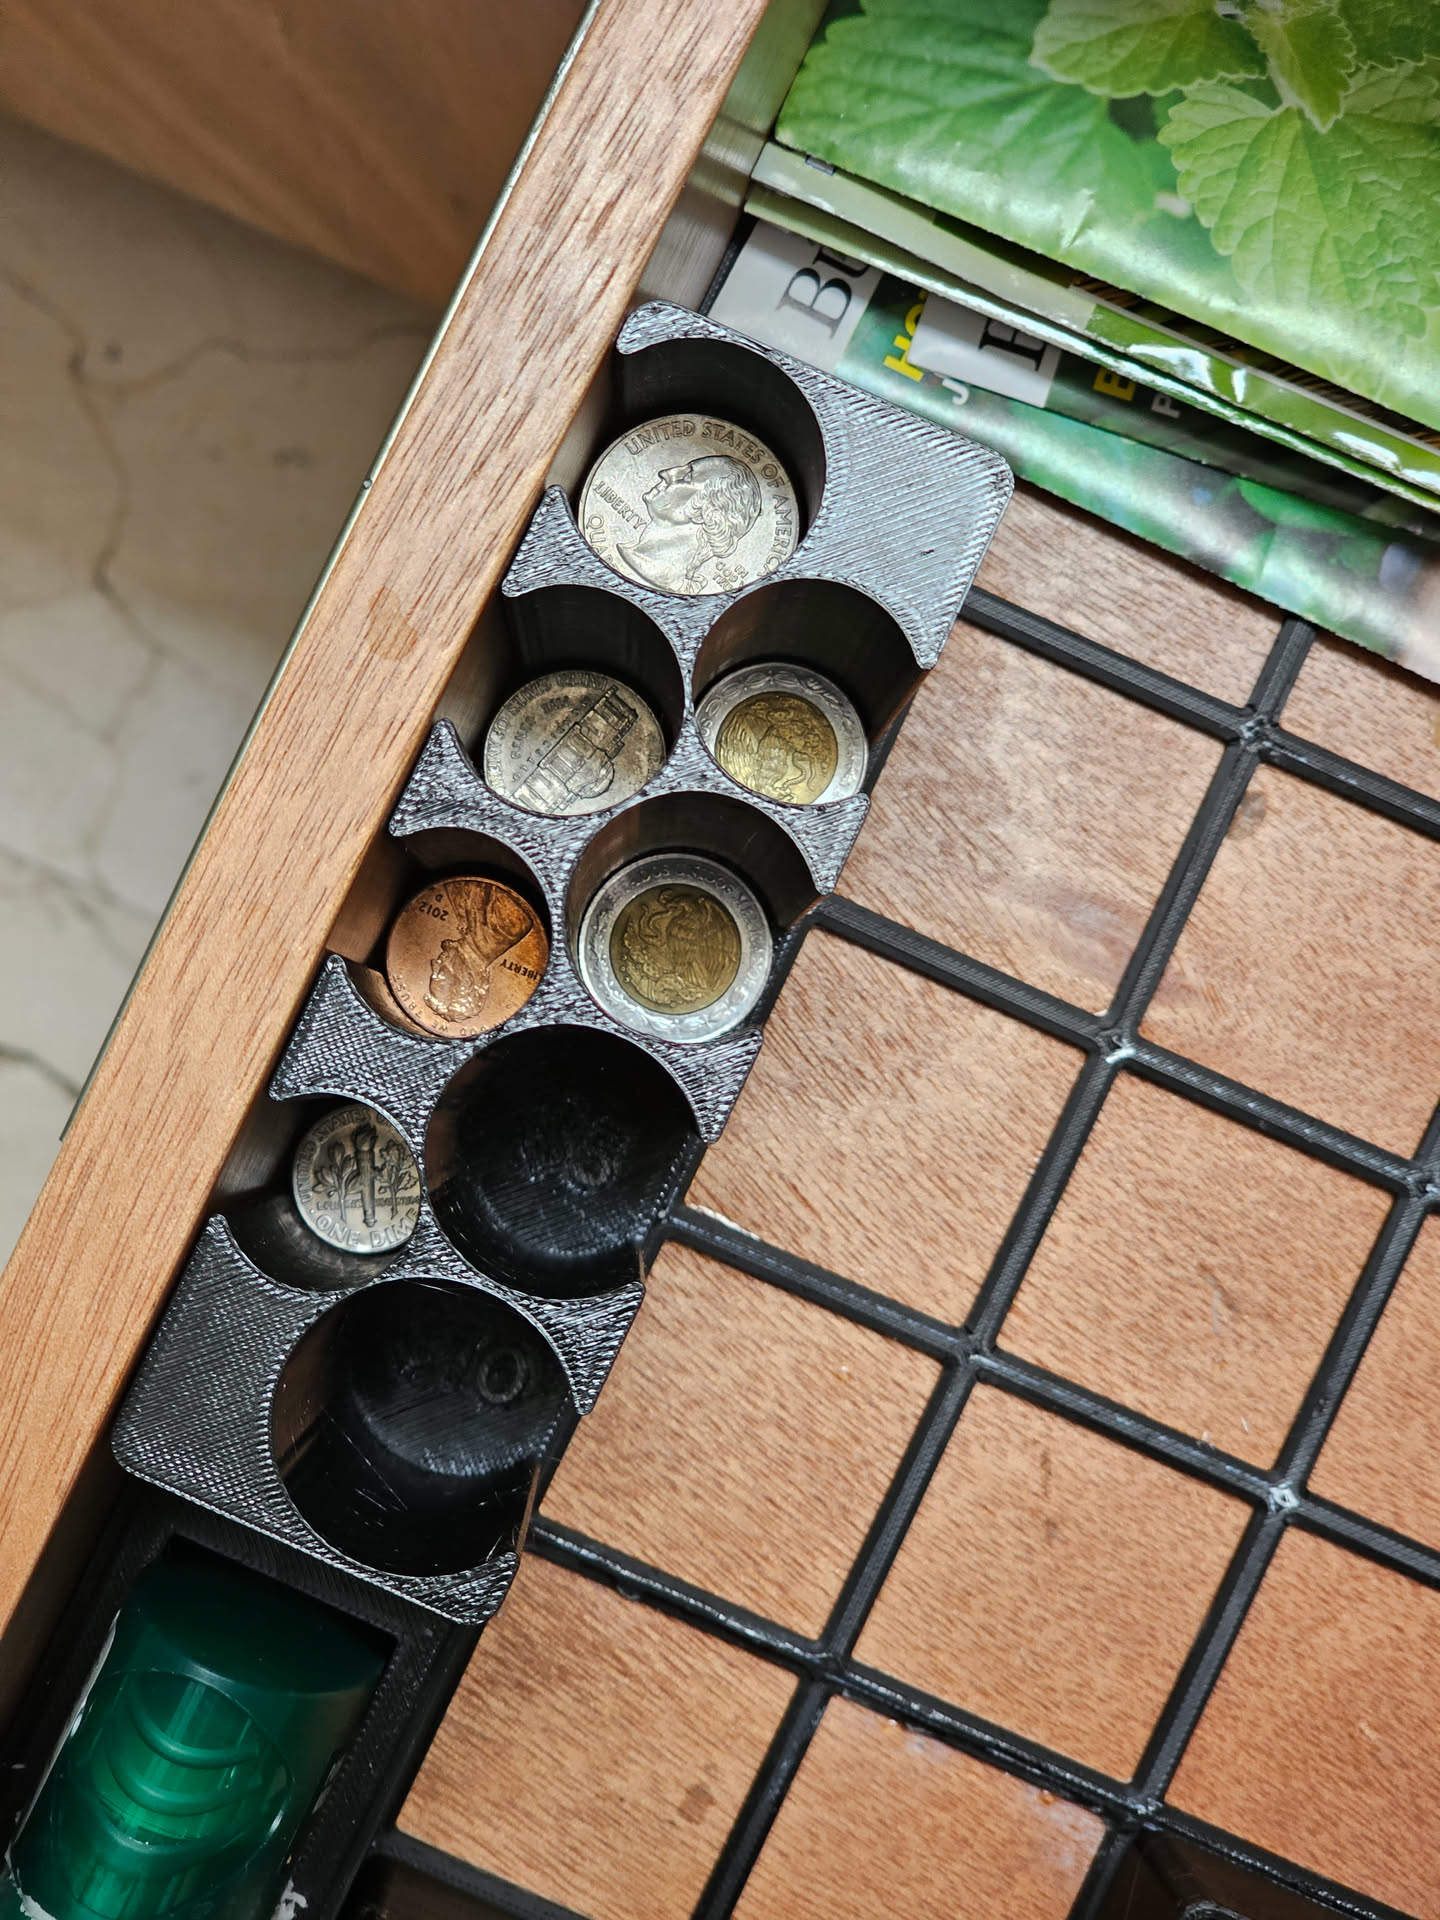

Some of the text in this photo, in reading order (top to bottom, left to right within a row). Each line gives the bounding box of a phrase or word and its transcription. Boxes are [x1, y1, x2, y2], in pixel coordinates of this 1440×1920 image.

[593, 480, 648, 530] LIBERTY
[624, 420, 793, 577] UNITED STATES OF AMERICA
[418, 901, 449, 922] 2012
[500, 958, 544, 982] LIBERTY
[316, 1208, 419, 1249] ONE DIME
